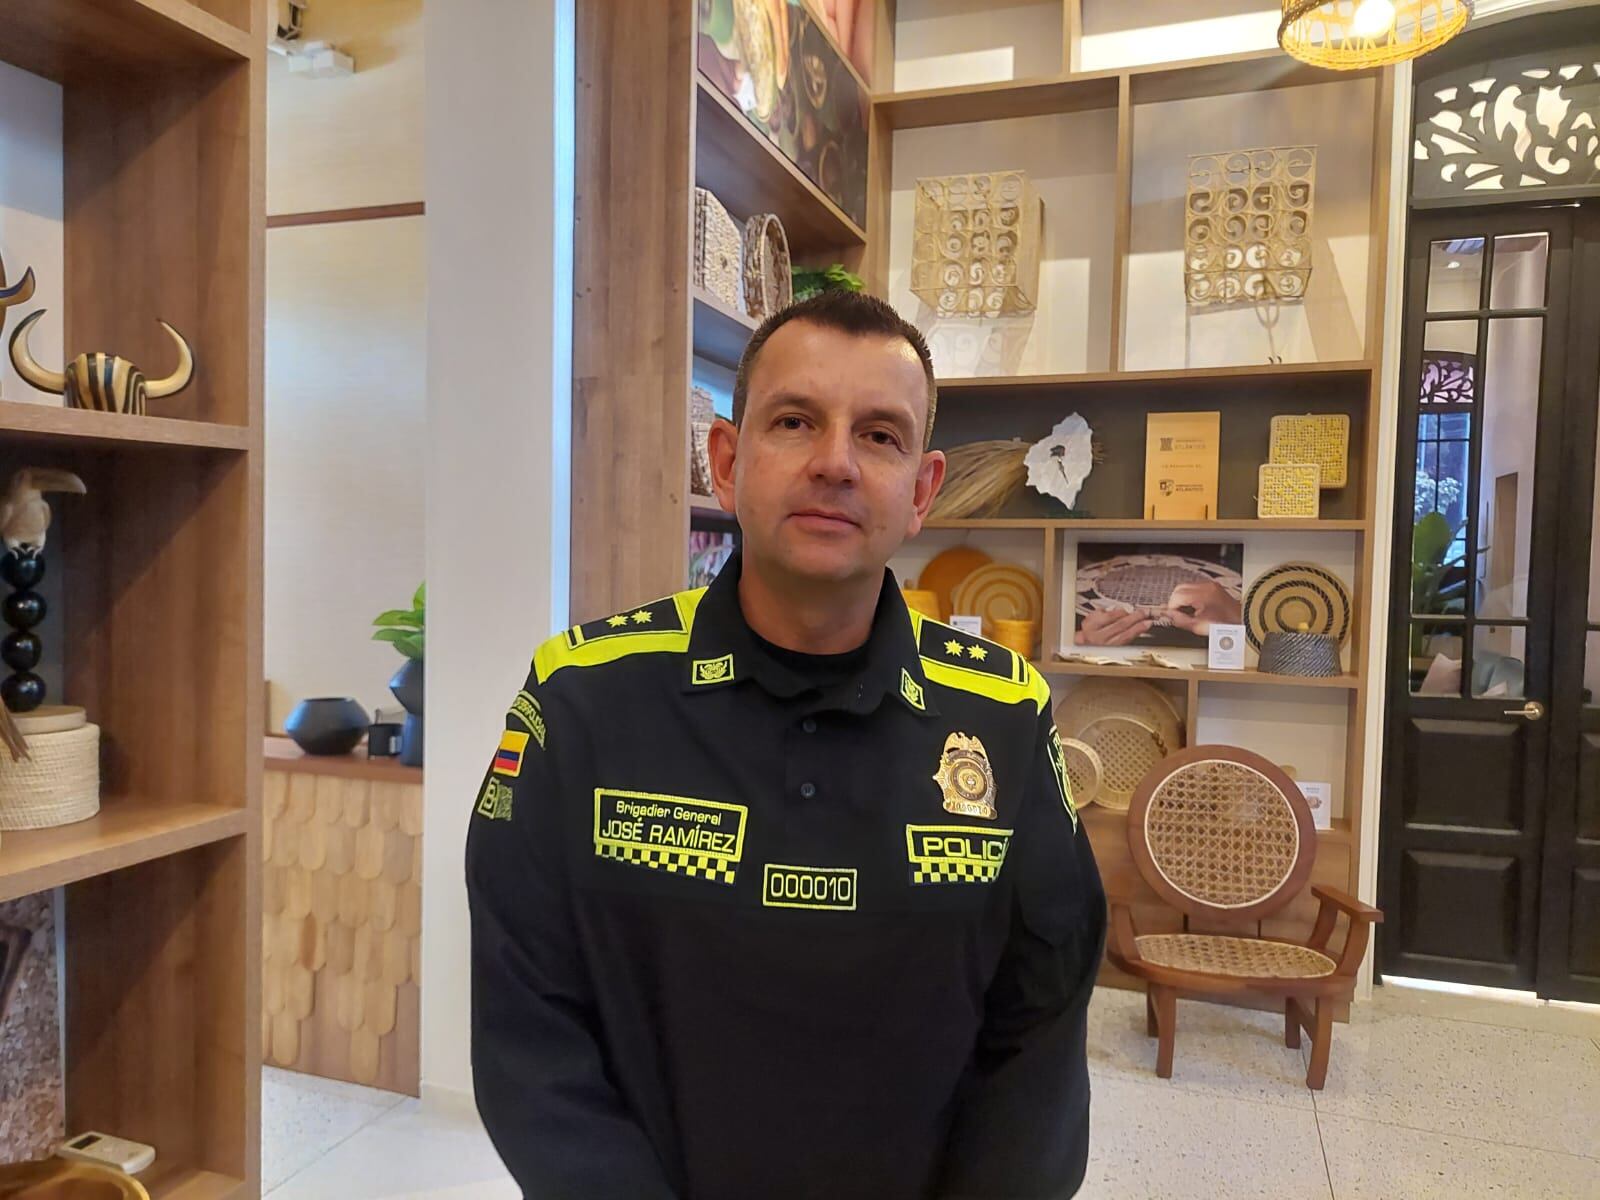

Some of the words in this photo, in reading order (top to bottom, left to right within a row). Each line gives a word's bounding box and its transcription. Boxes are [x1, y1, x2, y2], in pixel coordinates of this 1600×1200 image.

[616, 800, 670, 818] Brigadier
[673, 806, 722, 826] General
[602, 817, 644, 841] JOSÉ
[649, 824, 736, 853] RAMÍREZ
[770, 872, 851, 901] 000010
